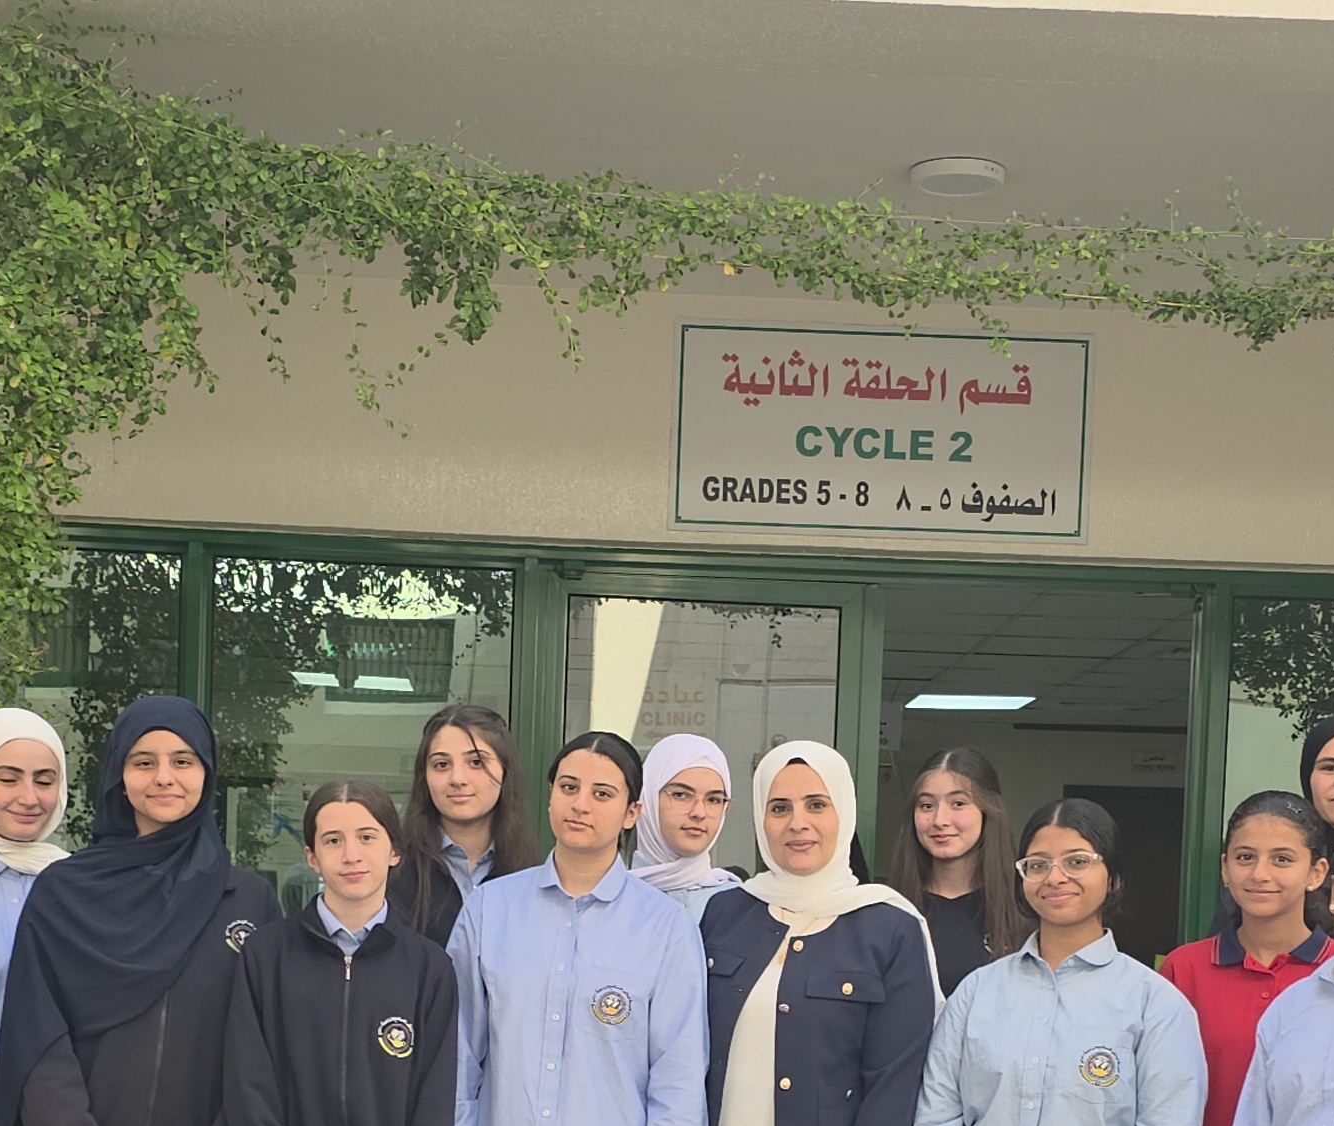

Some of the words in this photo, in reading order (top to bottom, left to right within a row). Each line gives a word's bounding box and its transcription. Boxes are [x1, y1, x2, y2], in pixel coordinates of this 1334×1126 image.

[721, 350, 829, 407] الثانية
[841, 357, 947, 402] الحلقة
[959, 363, 1032, 416] قسم
[795, 425, 935, 461] CYCLE
[948, 431, 973, 463] 2
[702, 476, 808, 505] GRADES
[816, 480, 831, 506] 5
[855, 481, 869, 507] 8
[961, 482, 1056, 523] الصفوف
[640, 711, 706, 727] CLINIC
